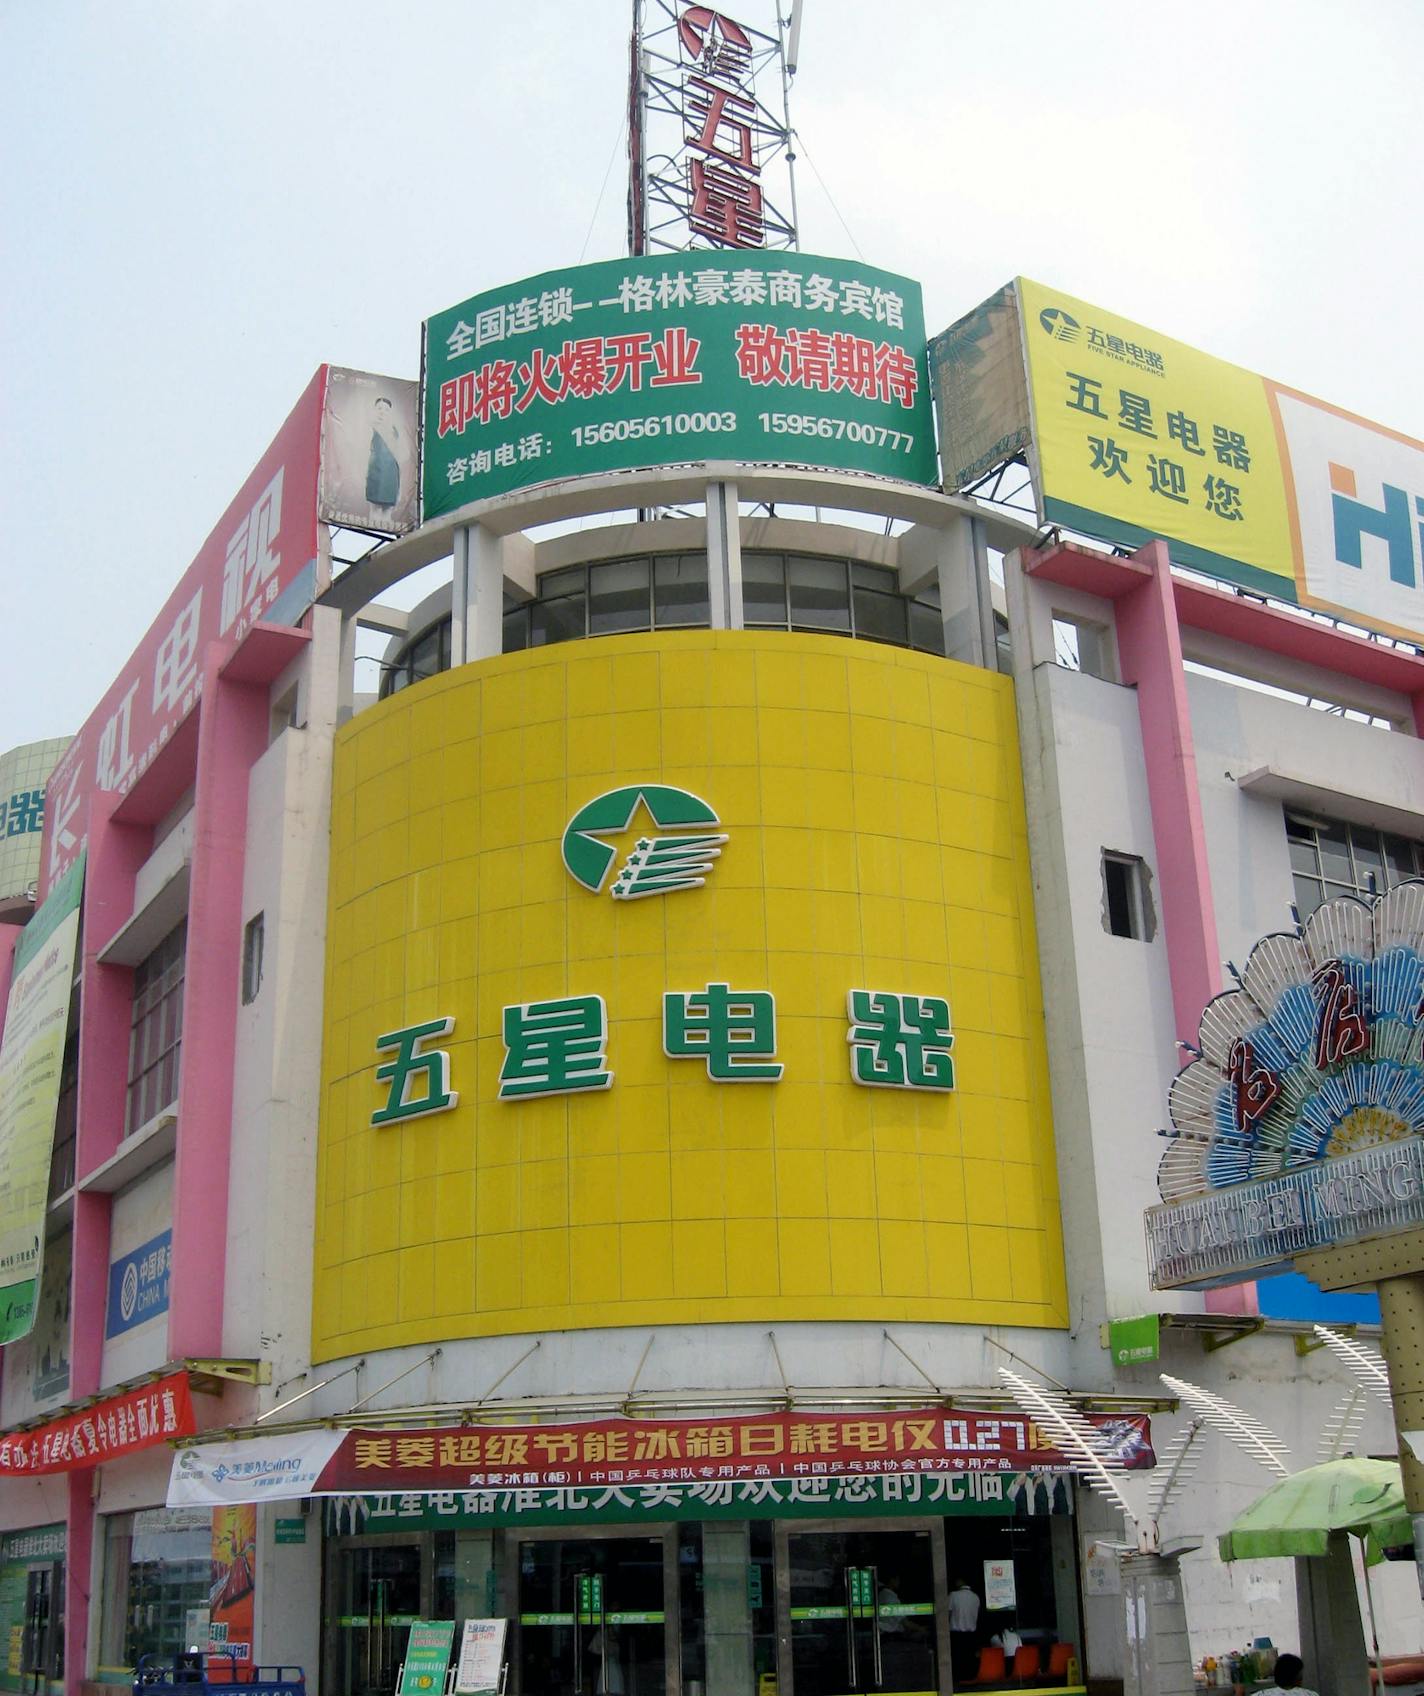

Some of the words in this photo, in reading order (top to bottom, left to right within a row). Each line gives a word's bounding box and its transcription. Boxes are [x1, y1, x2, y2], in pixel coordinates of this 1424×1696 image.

[437, 327, 703, 440] 即将火爆开业
[734, 323, 919, 410] 敬请期待
[1086, 325, 1164, 371] 五星电器
[1087, 344, 1105, 357] FIVE
[1105, 352, 1125, 364] STAR
[1126, 358, 1167, 379] APPLIANCE
[570, 411, 738, 449] 15605610003
[758, 412, 915, 455] 15956700777
[1065, 371, 1251, 474] 五星电器
[1086, 434, 1244, 522] 欢迎您
[49, 464, 285, 873] 长虹电视
[0, 788, 46, 842] 器
[371, 982, 956, 1128] 五星电器
[1153, 1206, 1233, 1259] HUAI
[1241, 1187, 1303, 1239] BEI
[1311, 1160, 1416, 1224] MING
